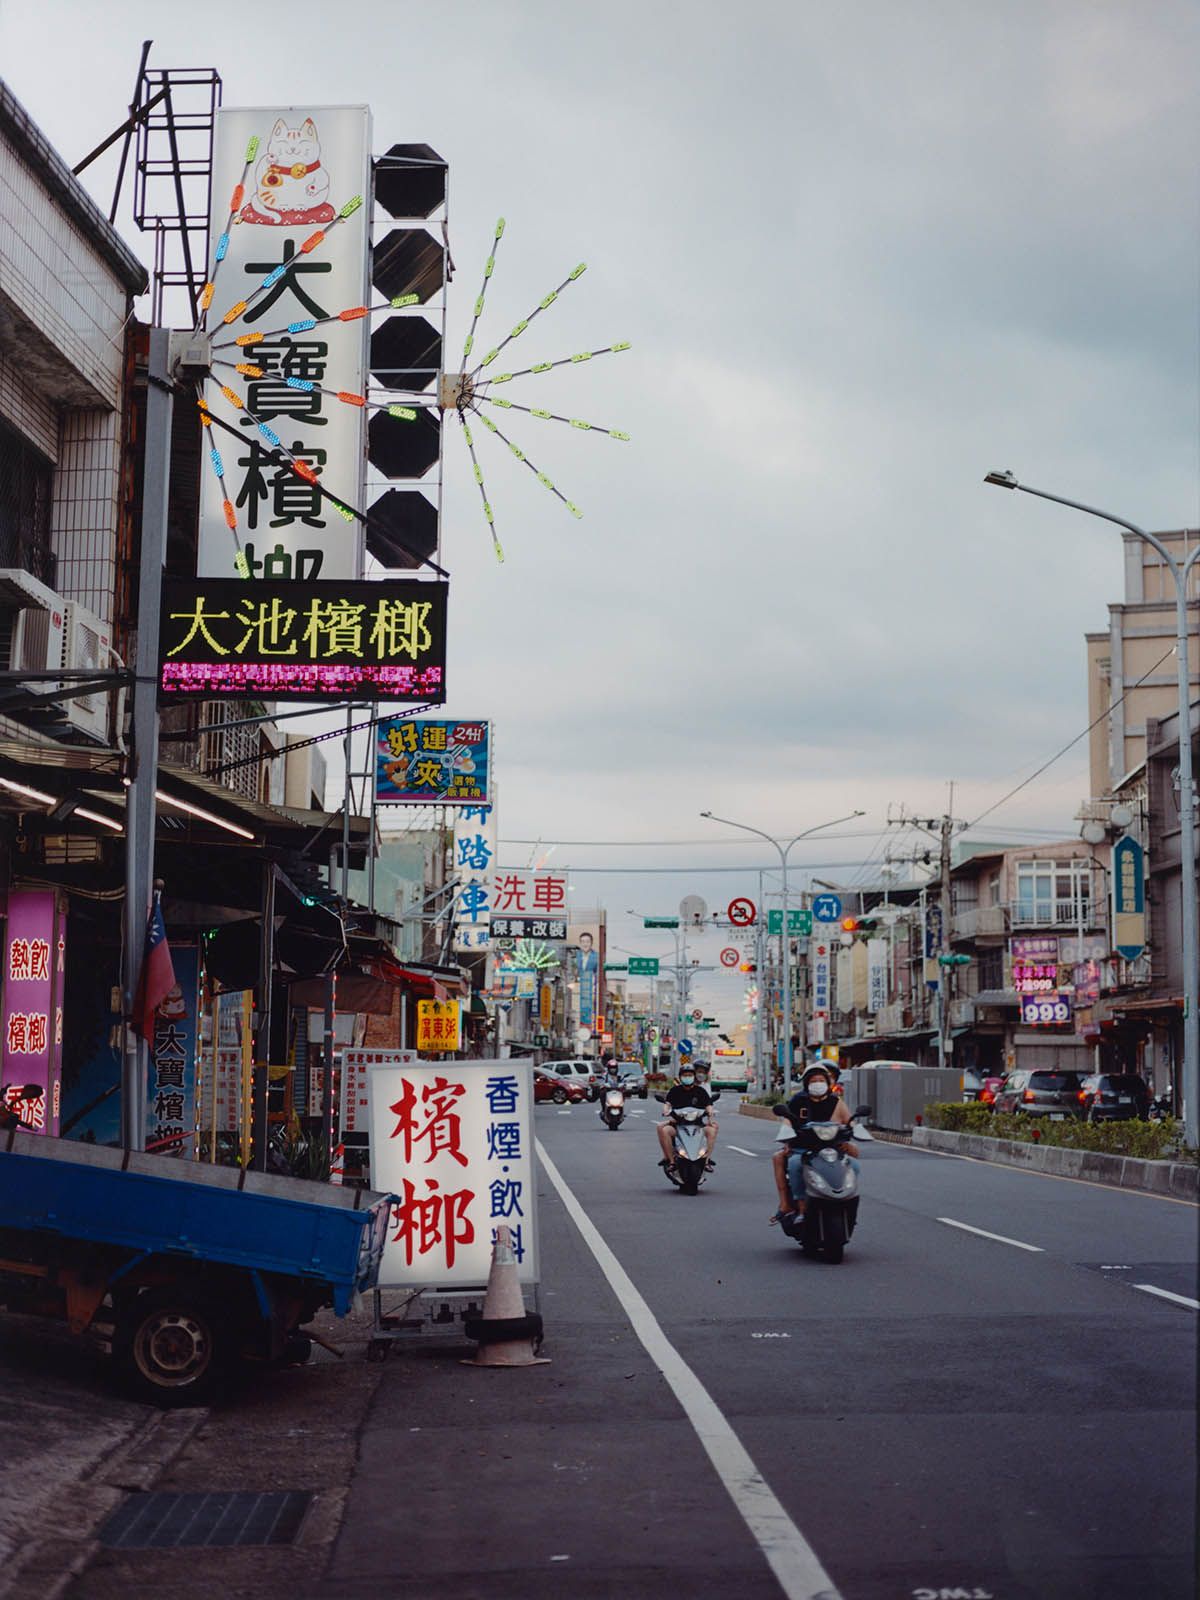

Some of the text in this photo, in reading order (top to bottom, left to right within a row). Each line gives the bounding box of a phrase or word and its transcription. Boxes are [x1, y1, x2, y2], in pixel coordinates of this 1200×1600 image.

[166, 596, 433, 660] 大池檳榔
[388, 722, 448, 757] 好運
[413, 760, 443, 787] 夾
[493, 875, 566, 913] 洗車
[10, 939, 50, 982] 熱飲
[1024, 1003, 1069, 1021] 999
[7, 1013, 48, 1055] 檳榔
[389, 1077, 476, 1269] 檳榔
